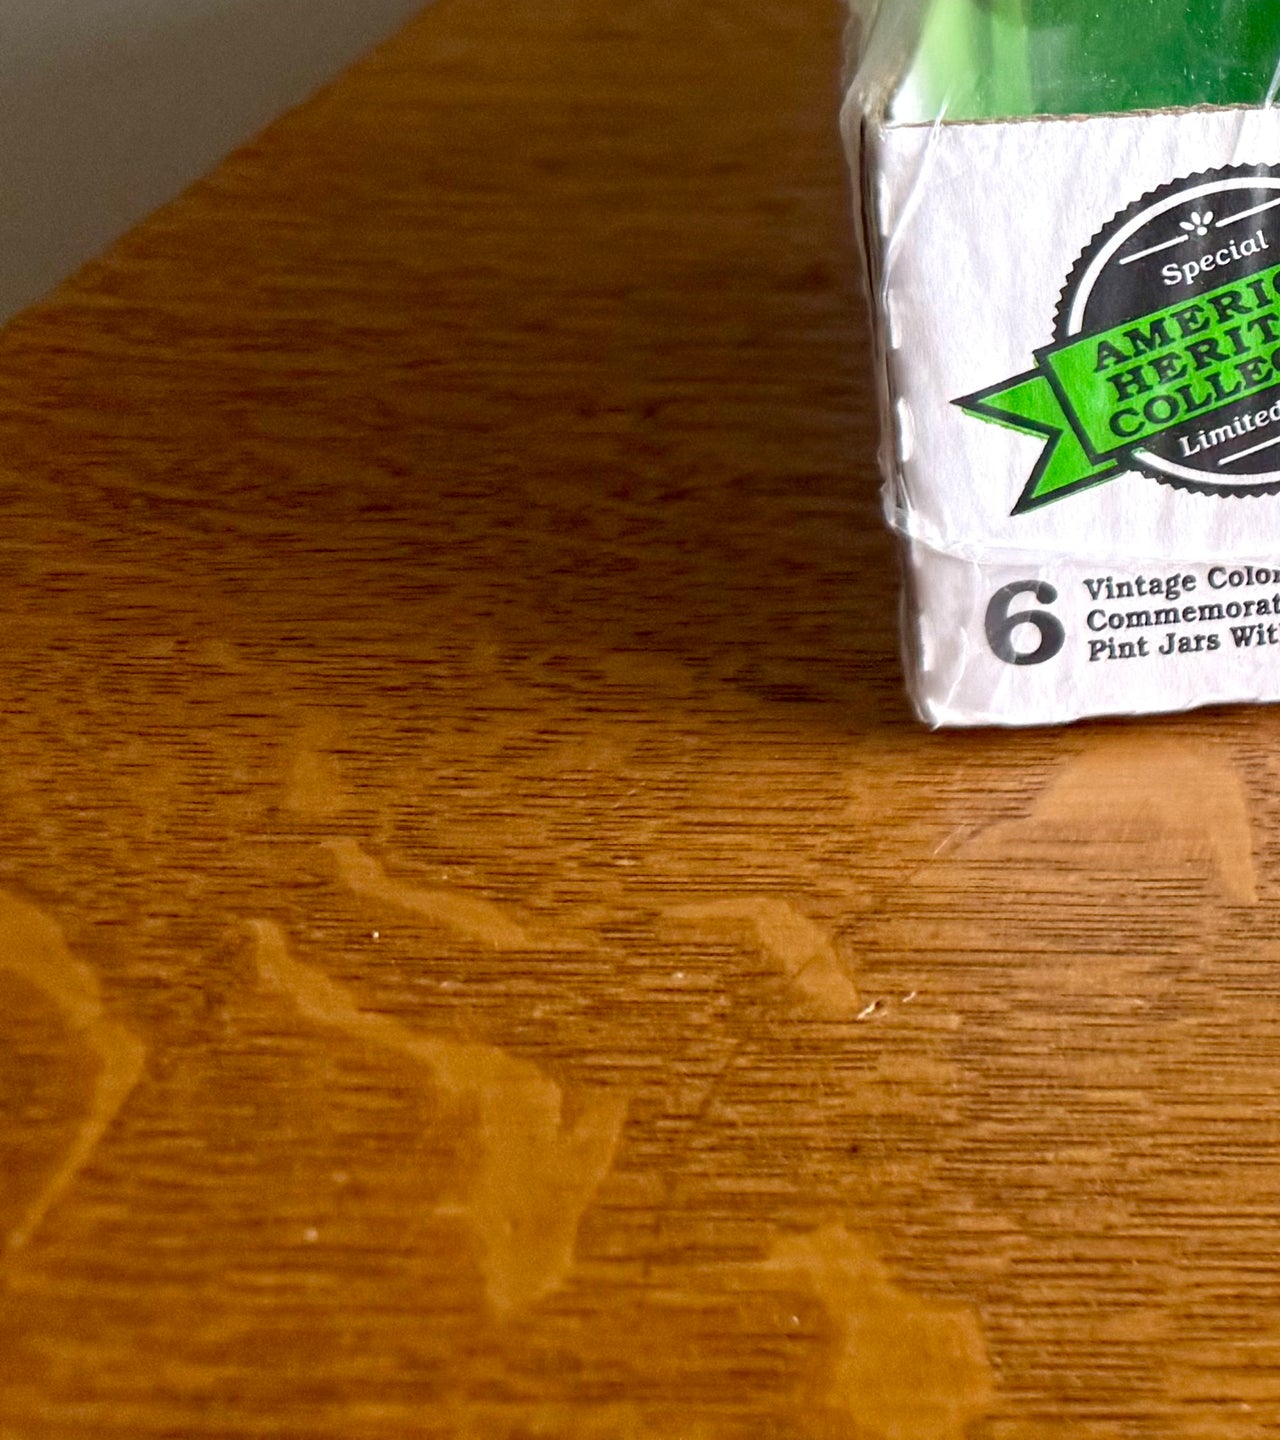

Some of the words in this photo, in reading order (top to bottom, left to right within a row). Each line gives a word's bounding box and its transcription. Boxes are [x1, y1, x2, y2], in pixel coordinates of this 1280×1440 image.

[1161, 229, 1270, 286] Special
[1082, 572, 1198, 601] Vintage
[984, 578, 1067, 666] 6
[1087, 635, 1151, 662] Pint
[1158, 631, 1222, 656] Jars
